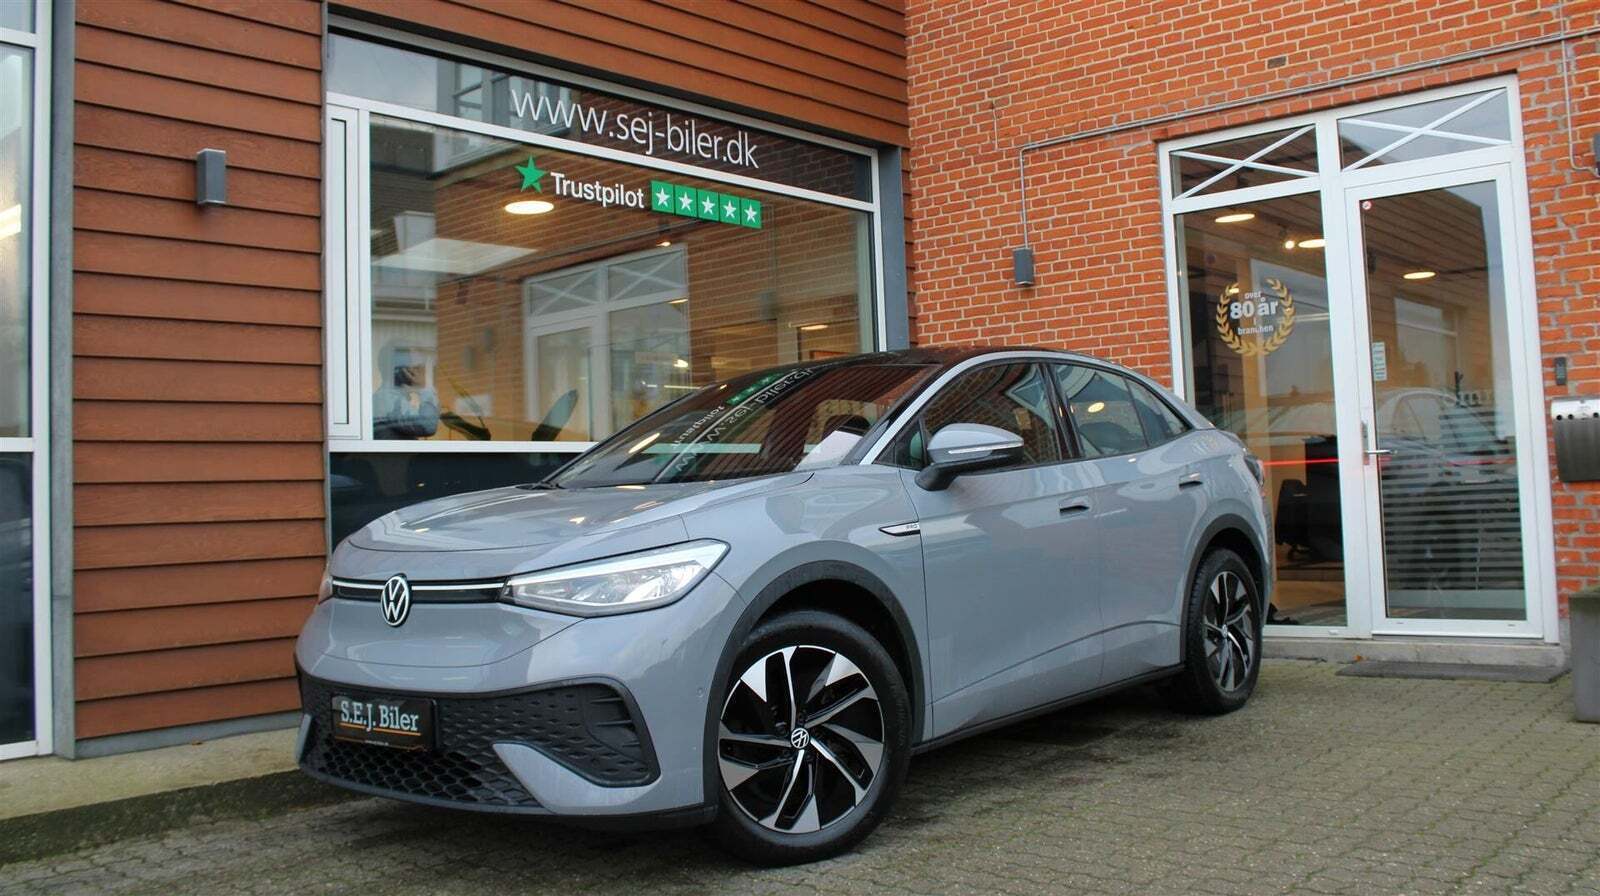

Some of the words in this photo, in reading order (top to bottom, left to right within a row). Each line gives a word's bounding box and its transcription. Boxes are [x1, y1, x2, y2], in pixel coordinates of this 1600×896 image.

[511, 88, 759, 168] www.sej-biler.dk
[550, 172, 645, 208] Trustpilot
[1230, 301, 1255, 319] 80
[1257, 296, 1279, 316] år
[340, 700, 377, 732] S.E.J.
[378, 704, 419, 731] Biler
